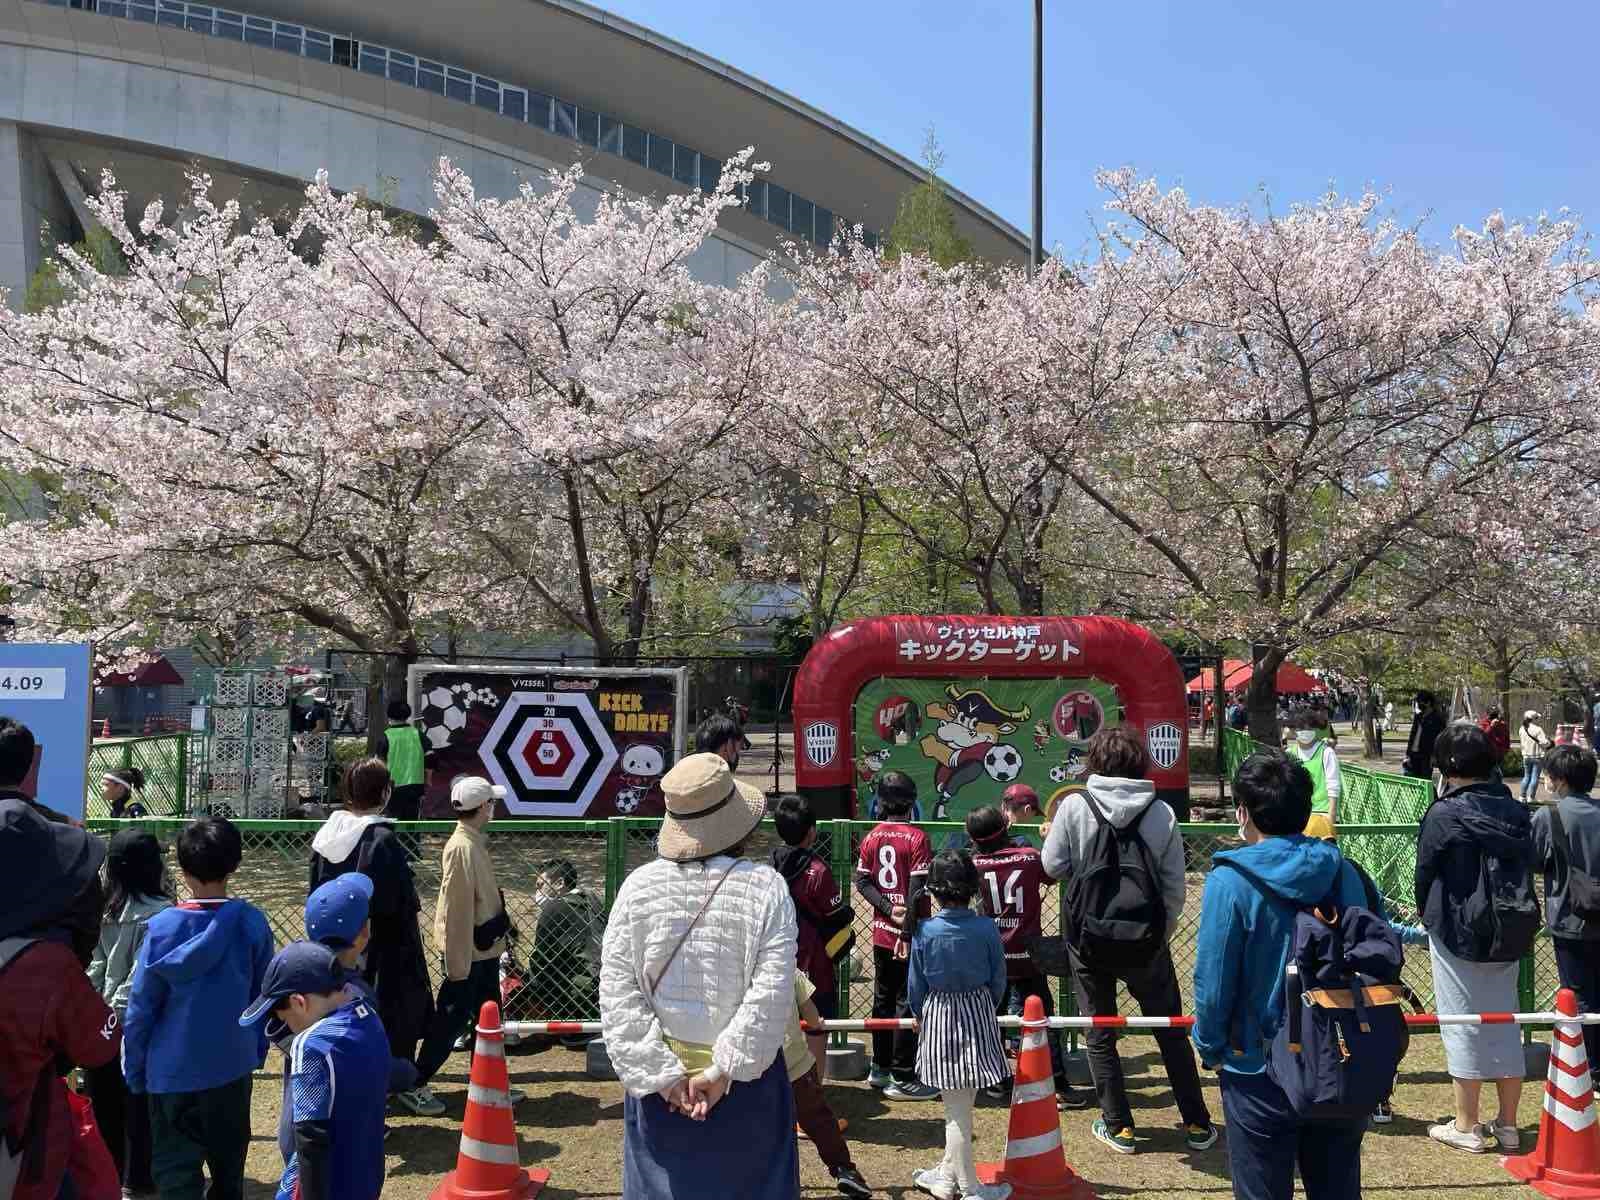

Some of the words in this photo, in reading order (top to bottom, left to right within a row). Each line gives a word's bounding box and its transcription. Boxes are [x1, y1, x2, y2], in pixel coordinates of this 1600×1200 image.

[938, 625, 1041, 640] ヴィッセル神戸
[899, 639, 1080, 662] キックターゲット
[519, 679, 545, 687] VISSEL
[545, 694, 555, 702] 10
[599, 693, 642, 711] KICK
[544, 707, 555, 716] 20
[542, 719, 554, 728] 30
[615, 714, 669, 731] DARTS
[541, 732, 553, 741] 40
[543, 750, 554, 758] 50
[878, 844, 898, 889] 8
[983, 869, 1024, 914] 14
